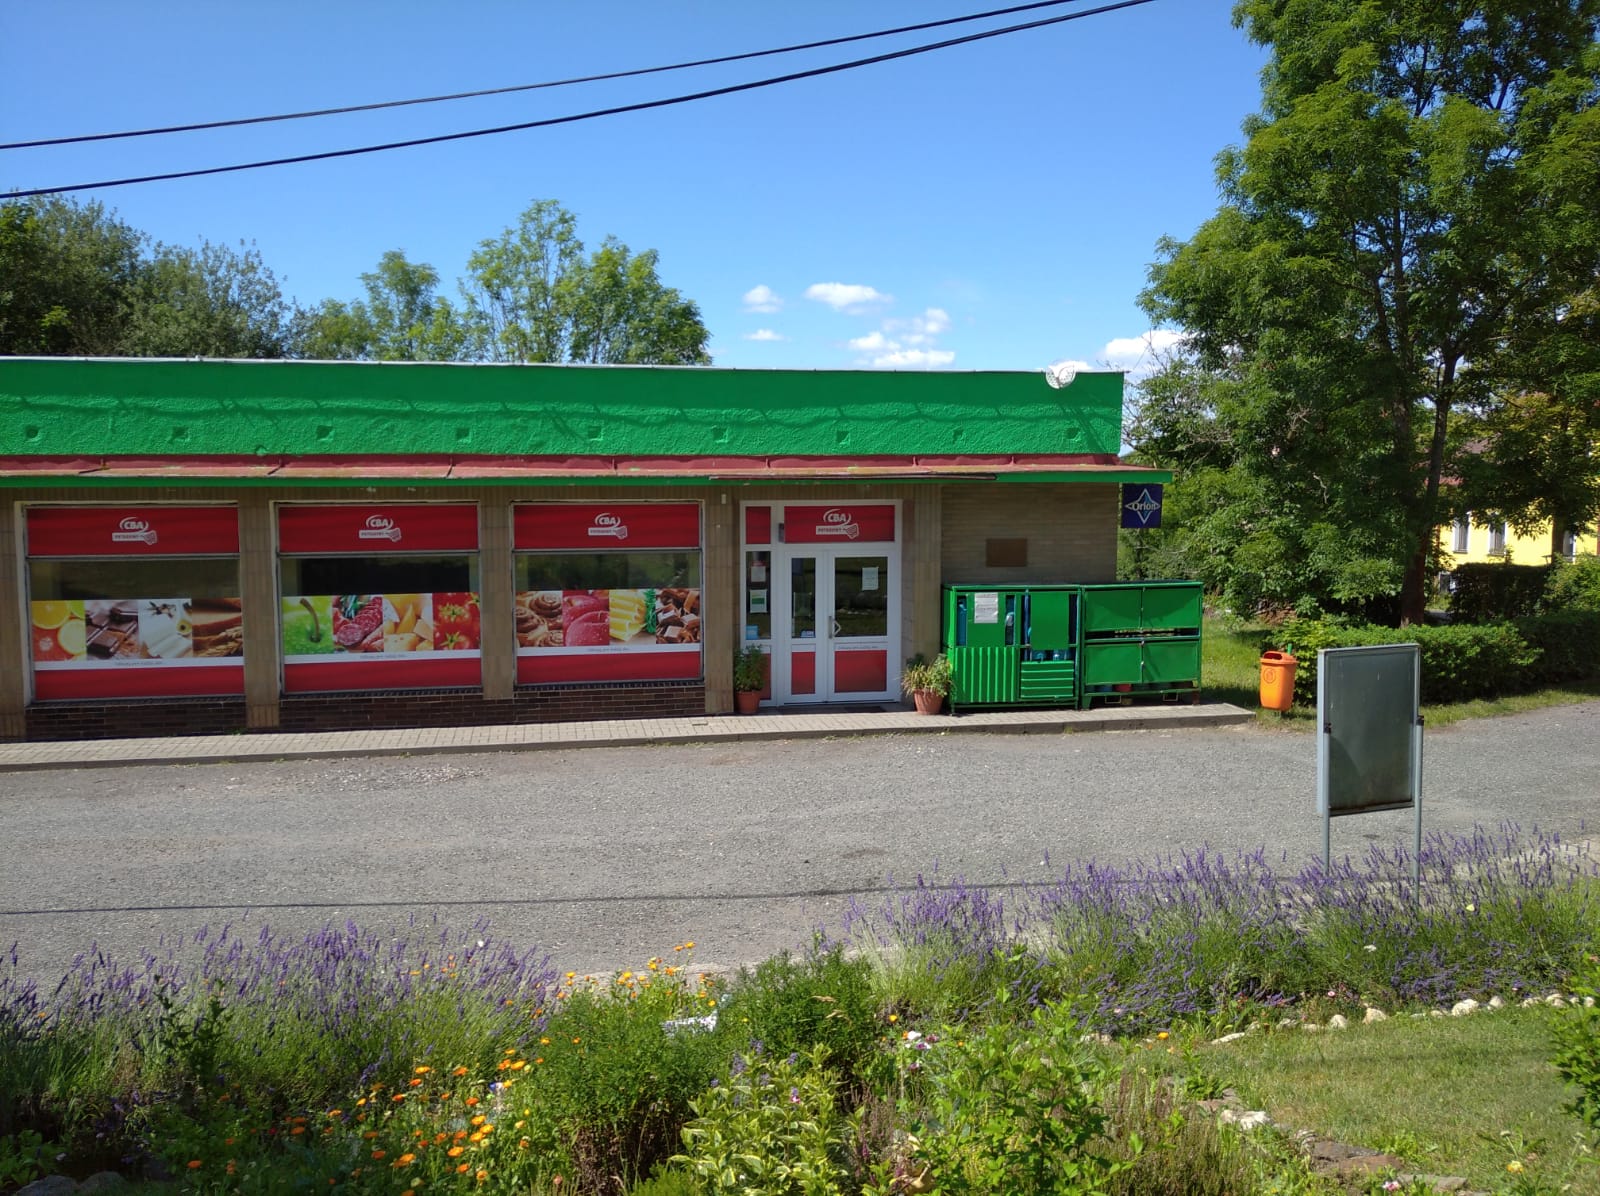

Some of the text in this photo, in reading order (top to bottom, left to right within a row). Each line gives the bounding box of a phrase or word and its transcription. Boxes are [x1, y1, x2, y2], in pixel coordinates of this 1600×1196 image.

[1132, 502, 1156, 511] Orion
[828, 513, 847, 522] CBA
[370, 519, 389, 527] CBA
